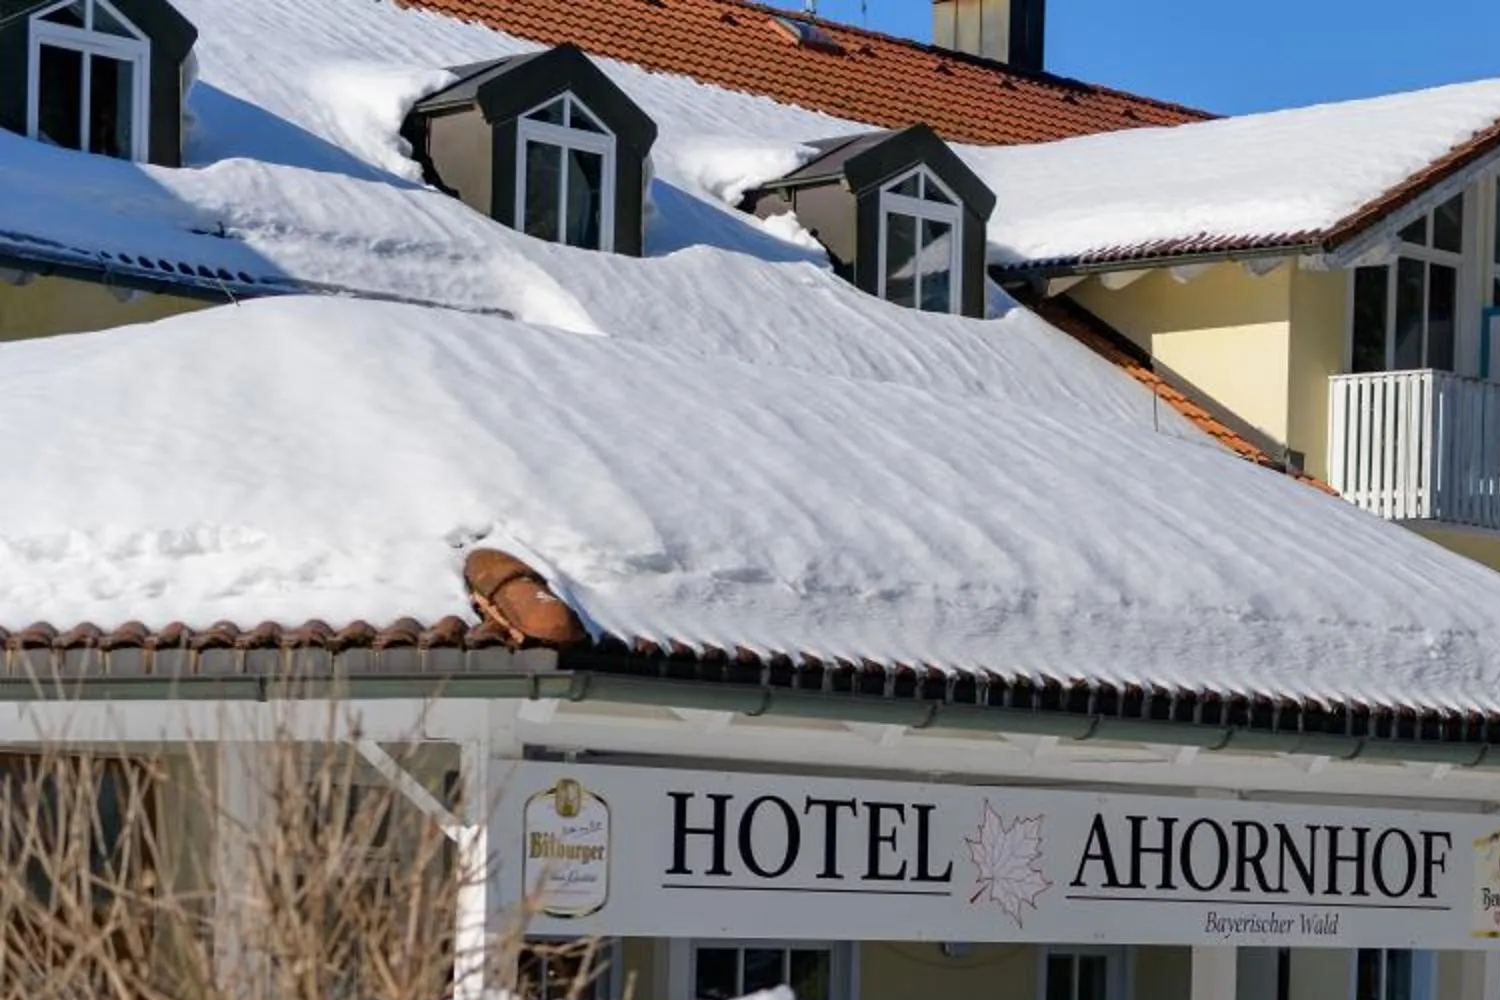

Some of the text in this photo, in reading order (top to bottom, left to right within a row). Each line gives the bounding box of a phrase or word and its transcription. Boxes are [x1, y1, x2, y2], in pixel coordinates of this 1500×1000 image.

[665, 791, 1453, 898] HOTEL AHORNHOF
[1204, 911, 1339, 939] Bayerischer Wald
